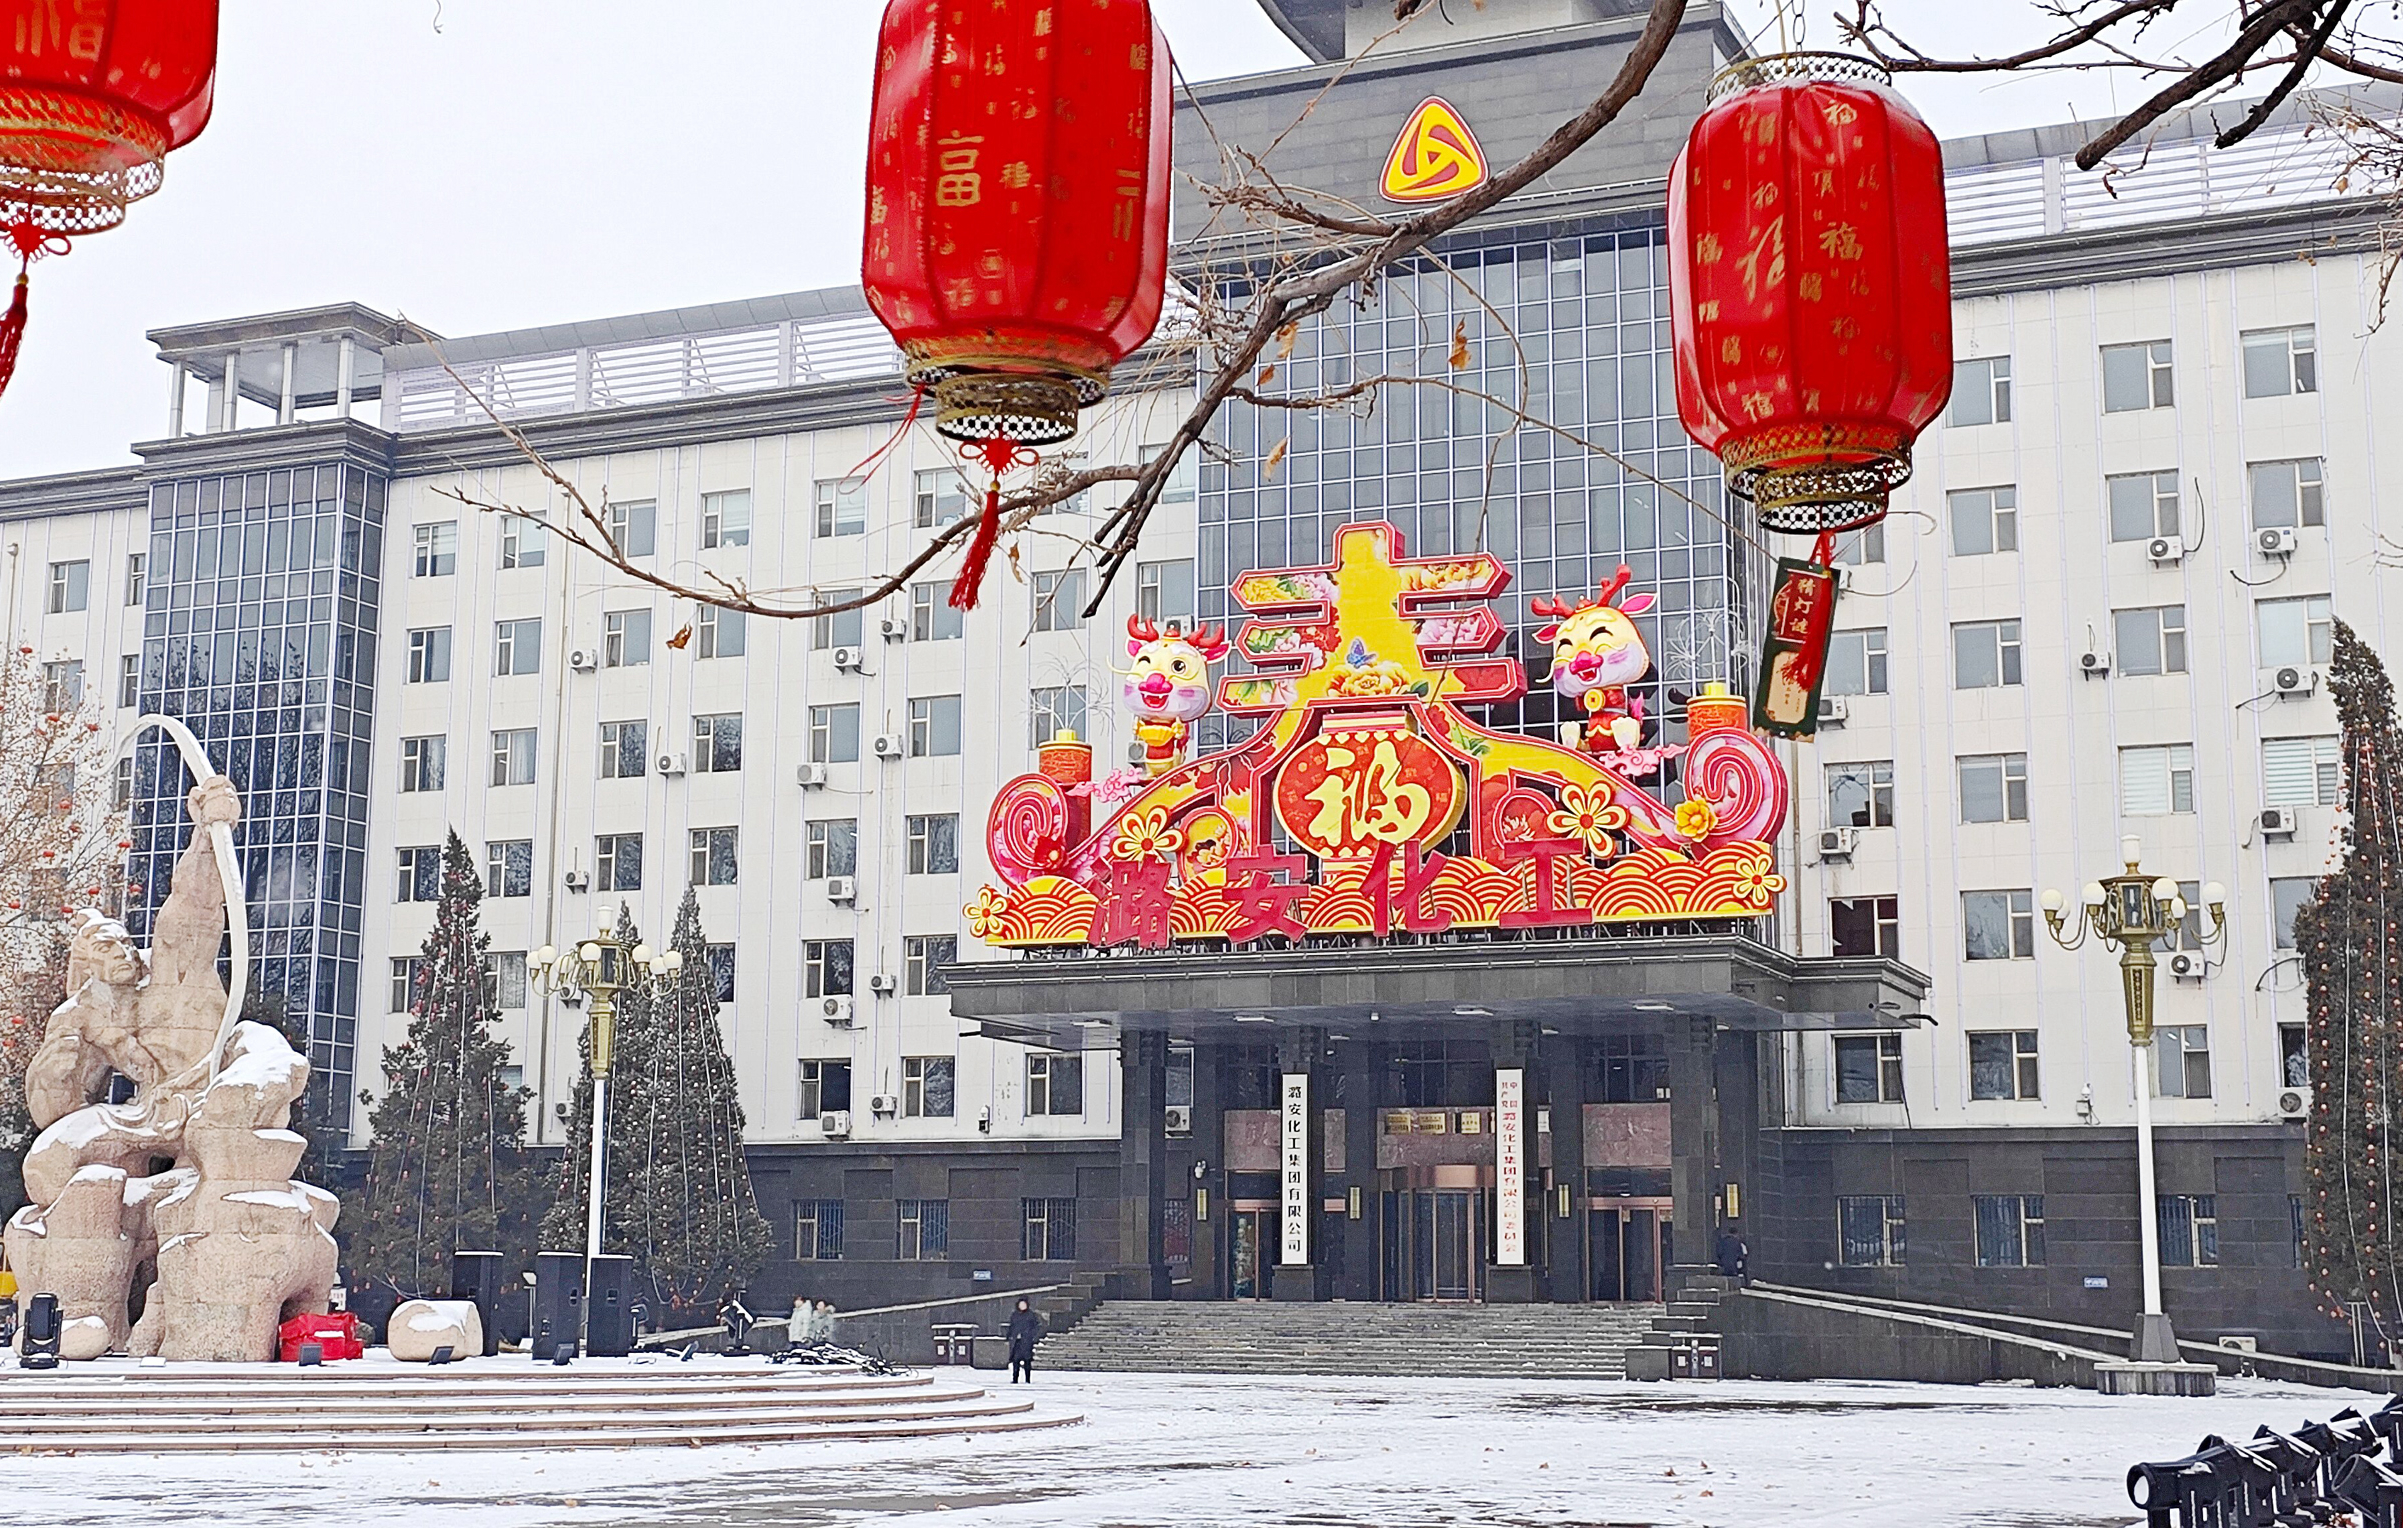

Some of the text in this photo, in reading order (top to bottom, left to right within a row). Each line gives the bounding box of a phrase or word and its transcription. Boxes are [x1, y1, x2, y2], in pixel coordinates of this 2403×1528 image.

[1789, 577, 1816, 634] 猜灯谜
[1304, 740, 1431, 847] 福
[1089, 838, 1594, 949] 潞安化工
[1287, 1086, 1302, 1253] 潞安化工集团有限公司
